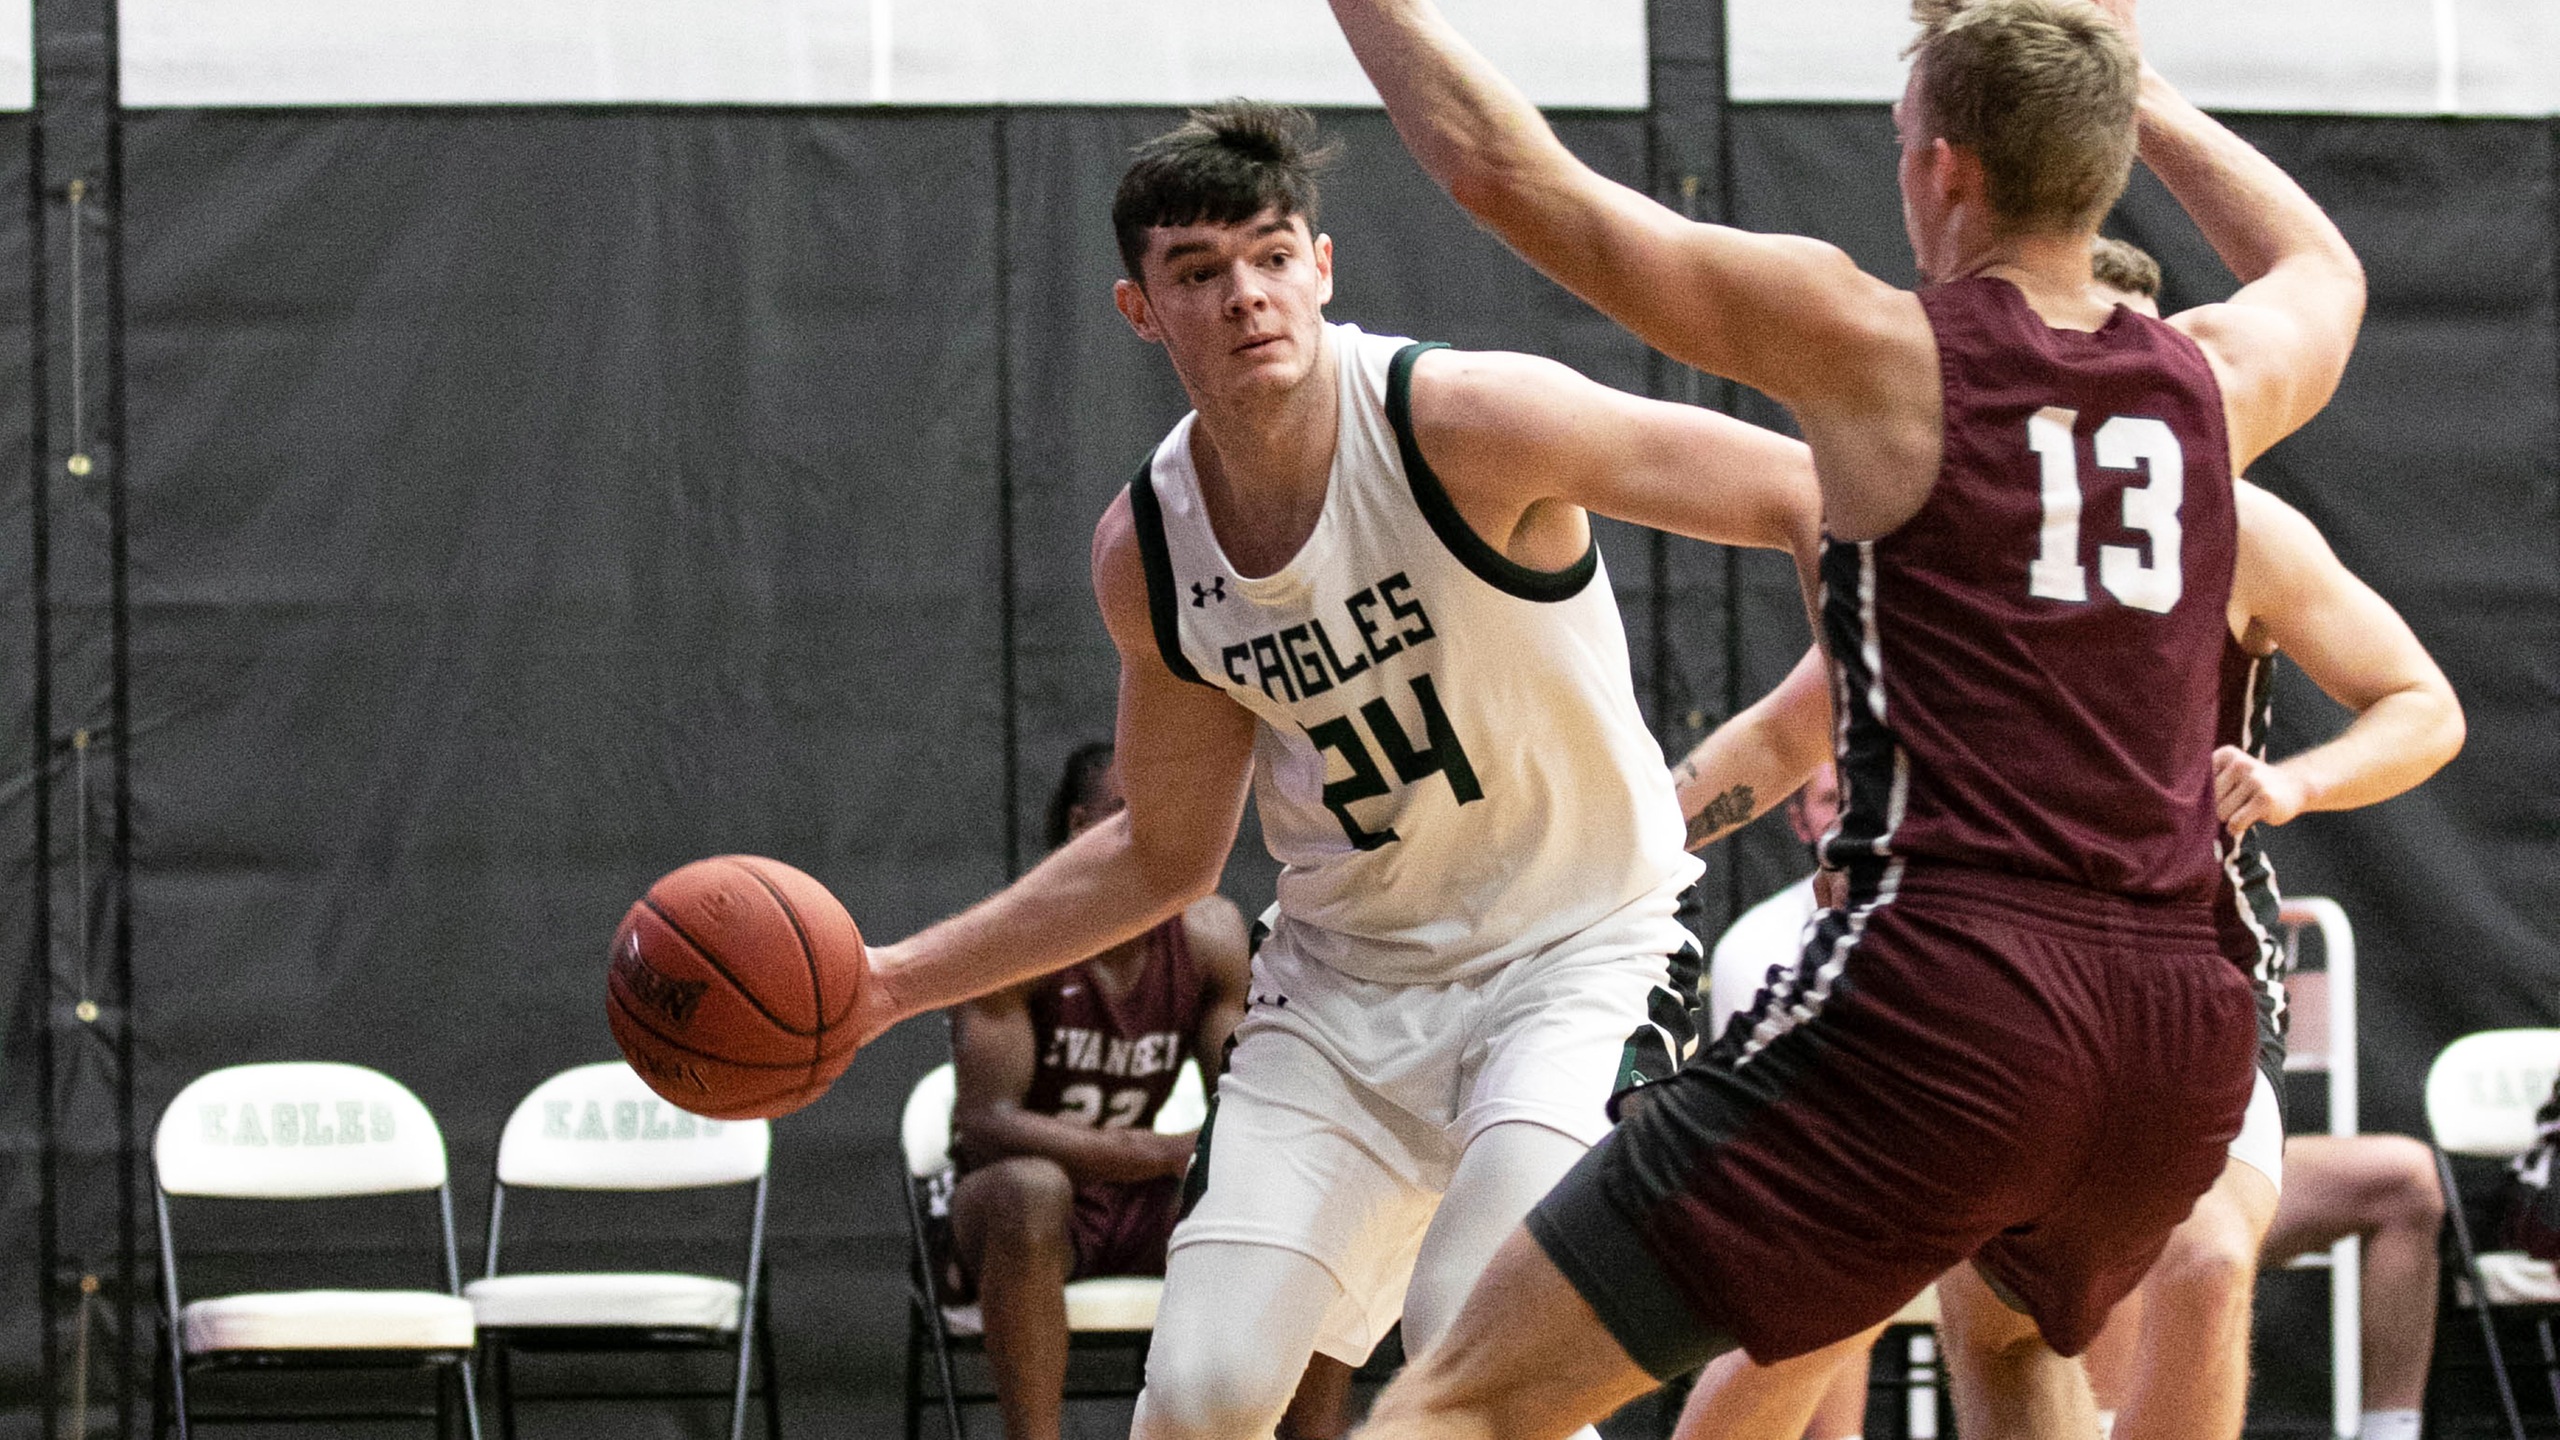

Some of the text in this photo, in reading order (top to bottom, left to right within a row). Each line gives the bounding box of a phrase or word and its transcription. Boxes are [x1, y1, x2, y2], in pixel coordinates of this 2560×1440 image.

[2027, 405, 2184, 614] 13
[1222, 571, 1436, 703] EAGLES
[1298, 673, 1485, 850] 24
[199, 1099, 397, 1147] EAGLES
